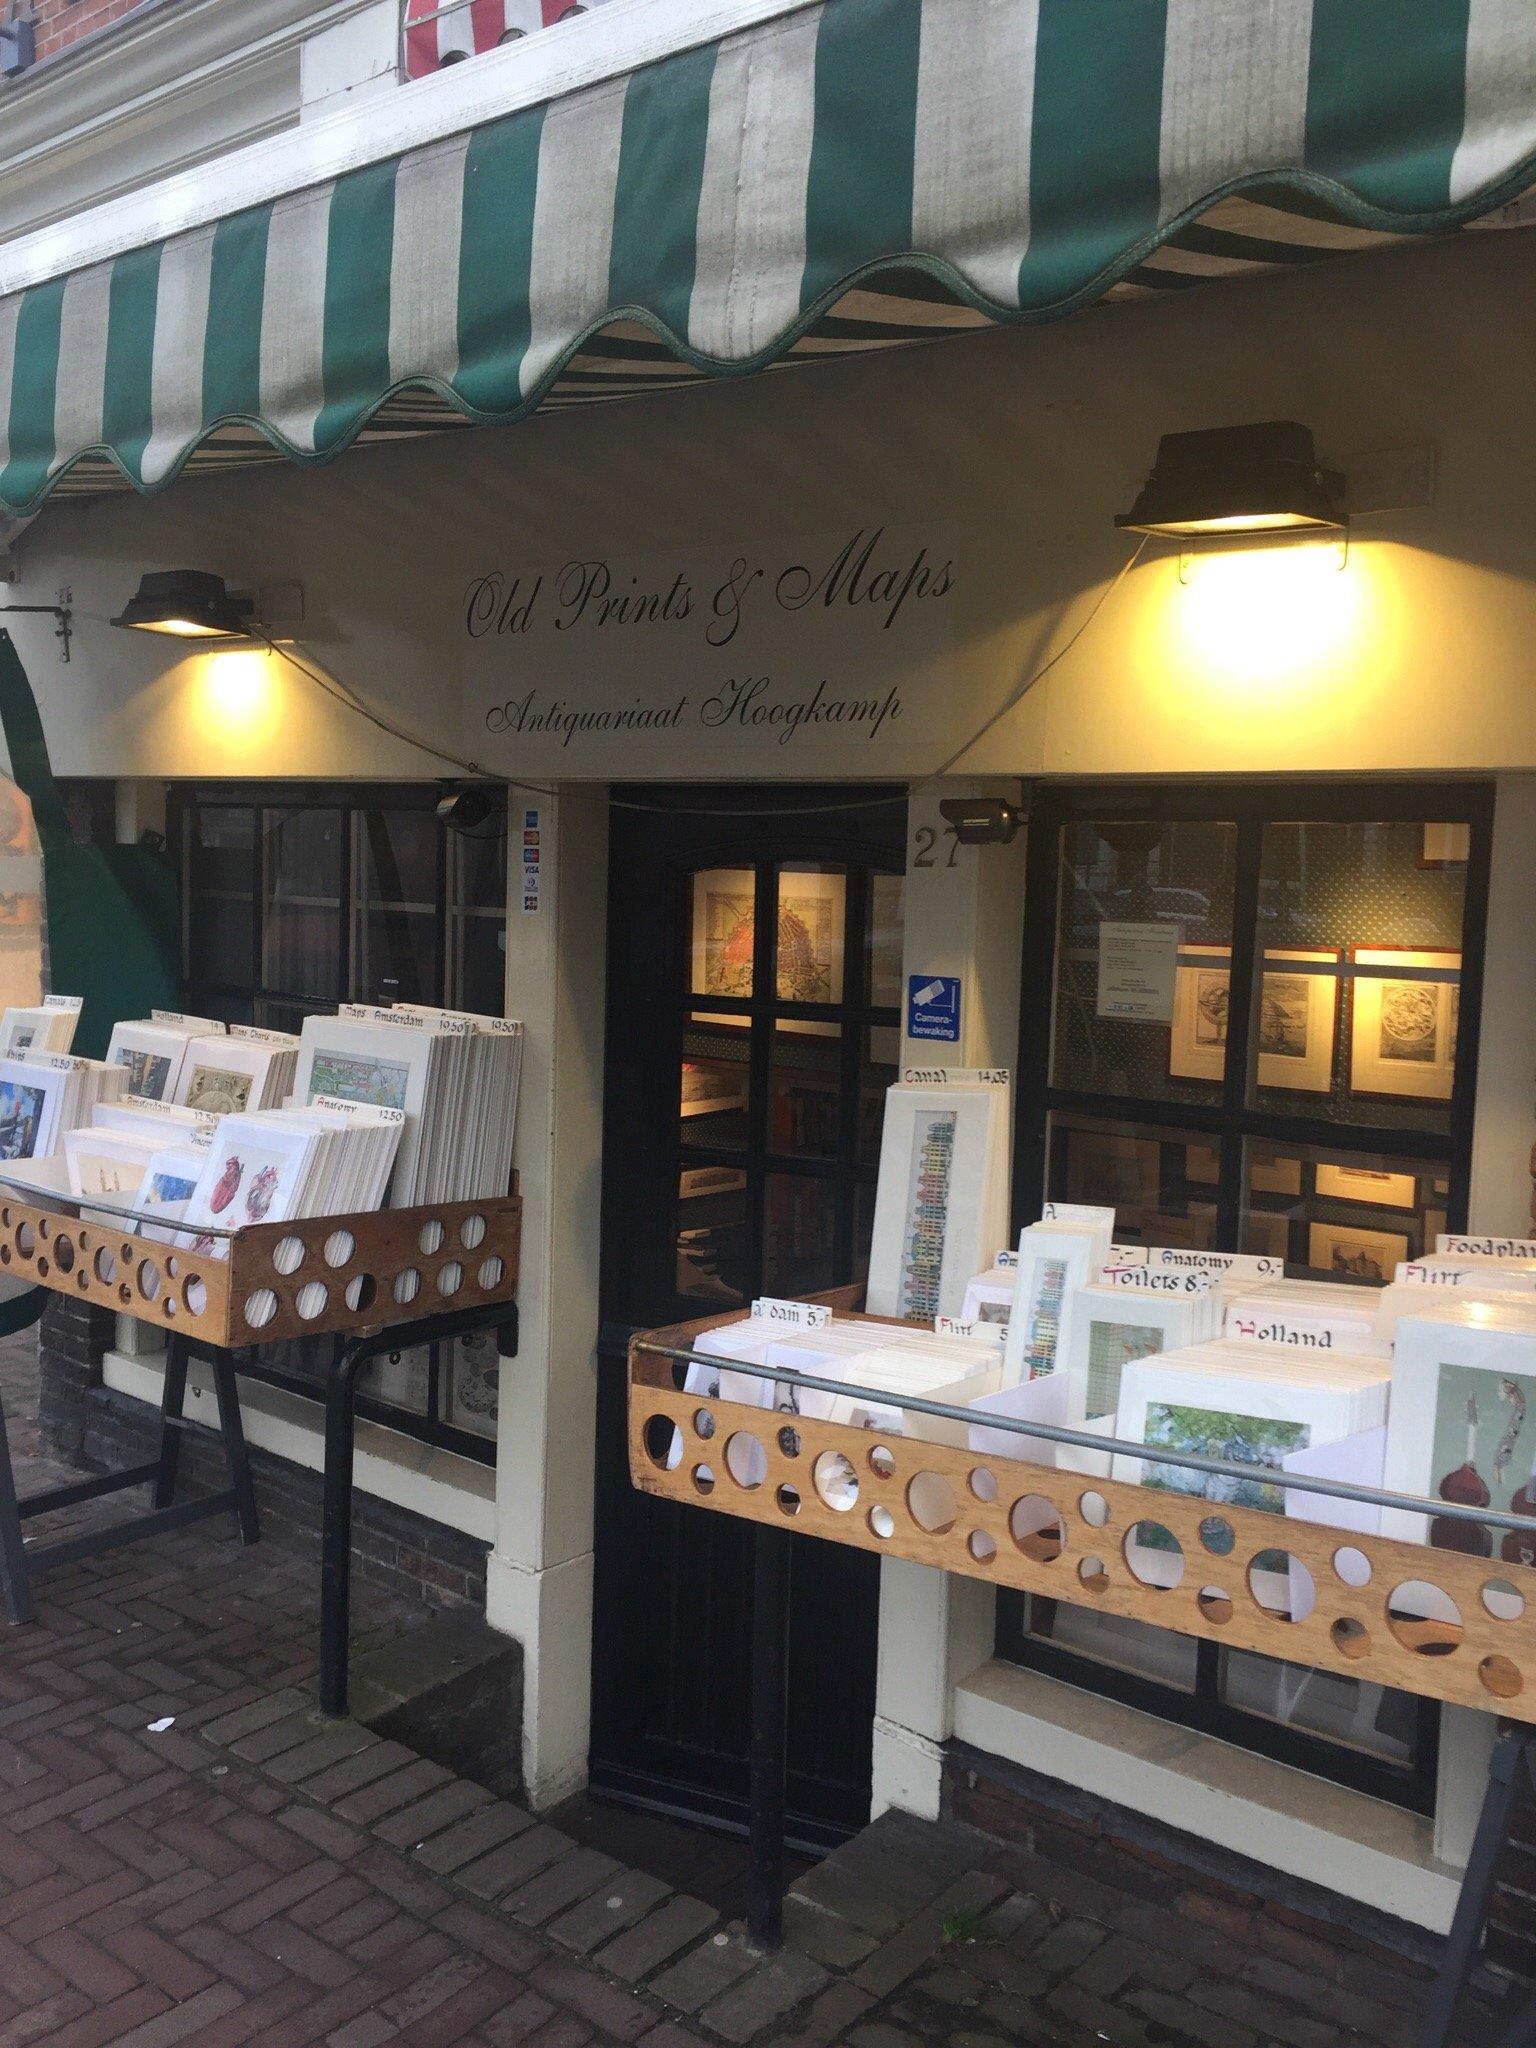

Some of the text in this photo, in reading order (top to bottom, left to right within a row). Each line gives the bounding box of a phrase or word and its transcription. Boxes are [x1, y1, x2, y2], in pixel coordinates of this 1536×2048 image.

[463, 526, 956, 648] Old Prints & Maps
[485, 677, 905, 748] Antiquariaat Hoogkamp
[913, 826, 958, 868] 27
[524, 865, 540, 874] VISA
[374, 1010, 424, 1028] Amsterdam
[914, 1012, 953, 1024] Camera-
[912, 1024, 955, 1039] bewaking
[316, 1096, 358, 1113] Anatomy
[1161, 1249, 1233, 1270] Anatomy
[1102, 1263, 1180, 1292] Toilets
[1405, 1264, 1473, 1287] Flirt
[940, 1317, 978, 1336] Flirt
[1235, 1319, 1333, 1349] Holland
